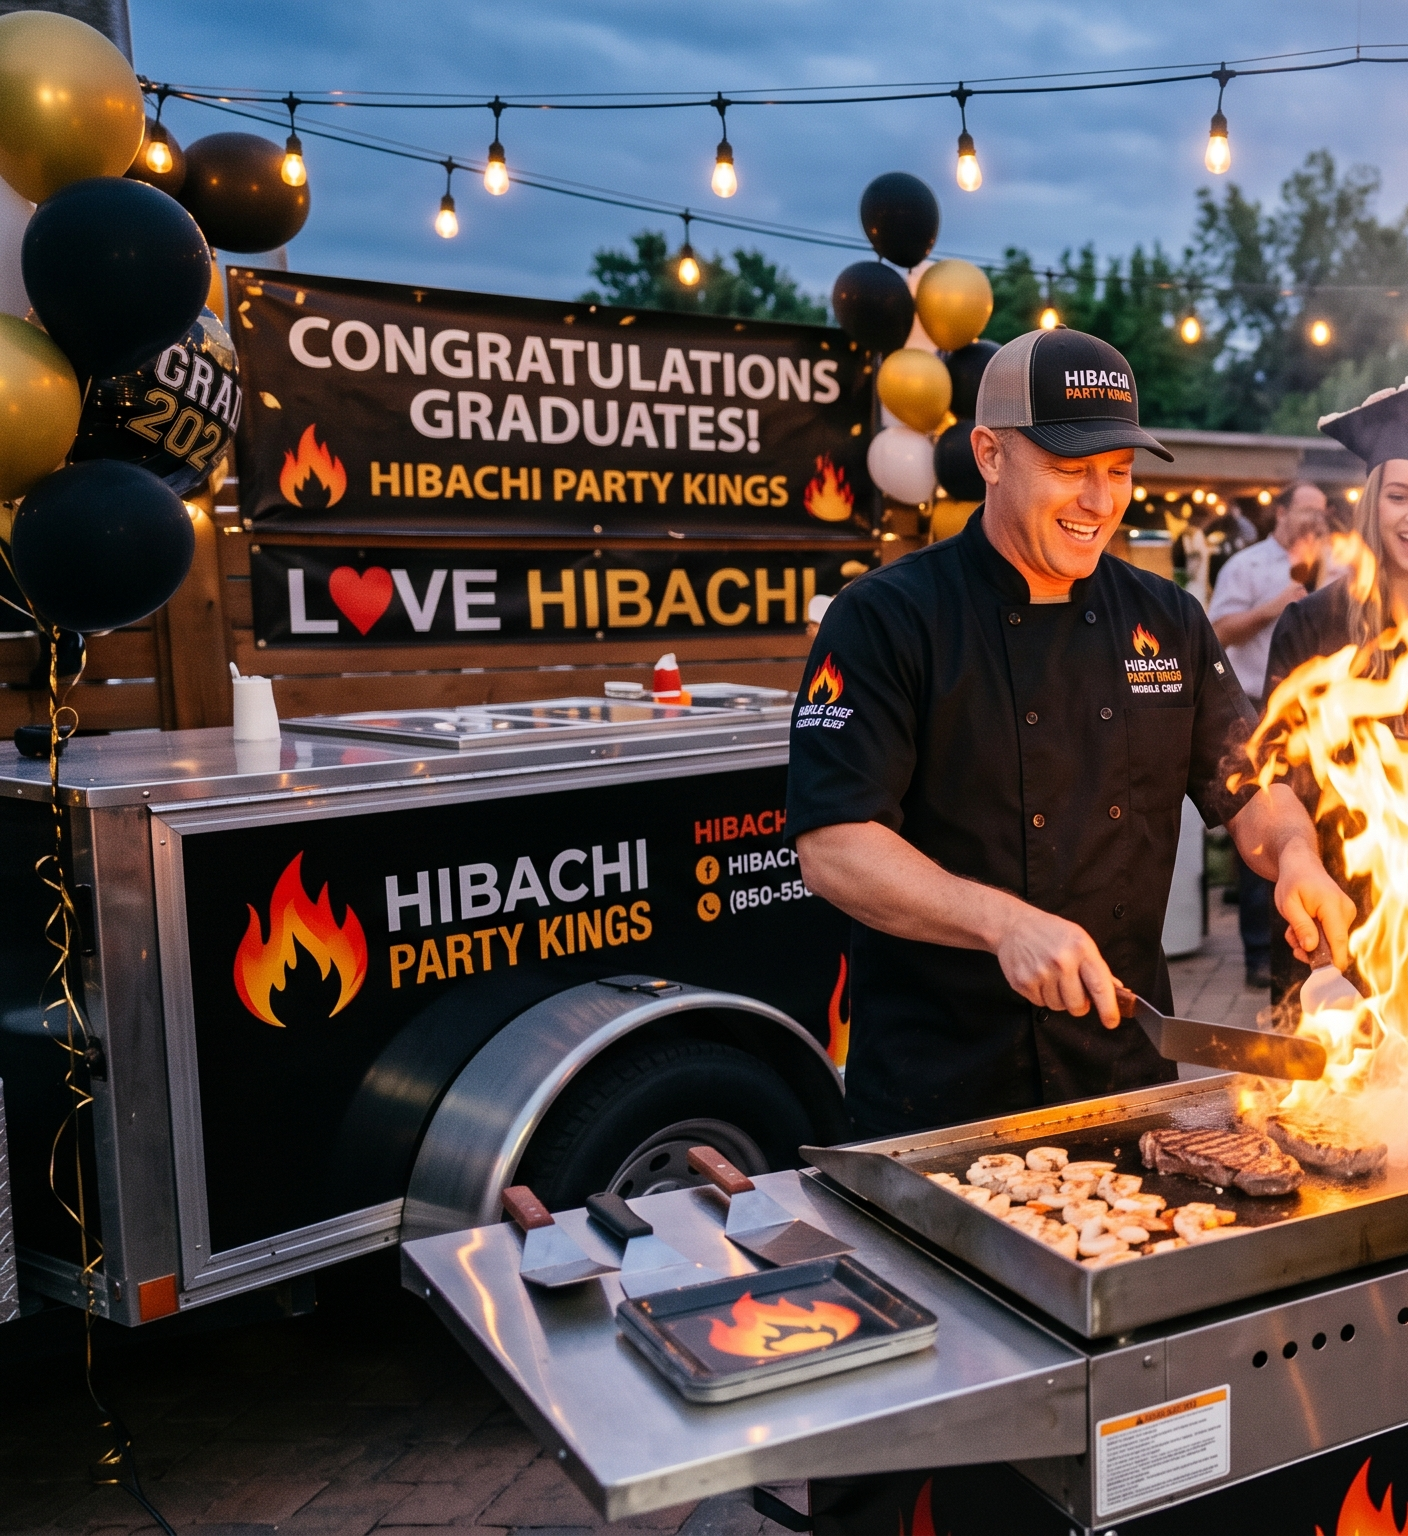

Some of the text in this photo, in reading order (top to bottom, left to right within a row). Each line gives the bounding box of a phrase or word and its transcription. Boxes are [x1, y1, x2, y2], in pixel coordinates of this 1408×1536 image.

[288, 316, 841, 404] CONGRATULATIONS
[410, 389, 760, 454] GRADUATES!
[1065, 387, 1105, 400] PARTY
[125, 388, 232, 472] 202
[370, 461, 789, 508] HIBACHI PARTY KINGS
[527, 567, 816, 630] HIBACHI
[1124, 658, 1179, 672] HIBACHI
[385, 838, 649, 932] HIBACHI
[389, 900, 653, 989] PARTY KINGS
